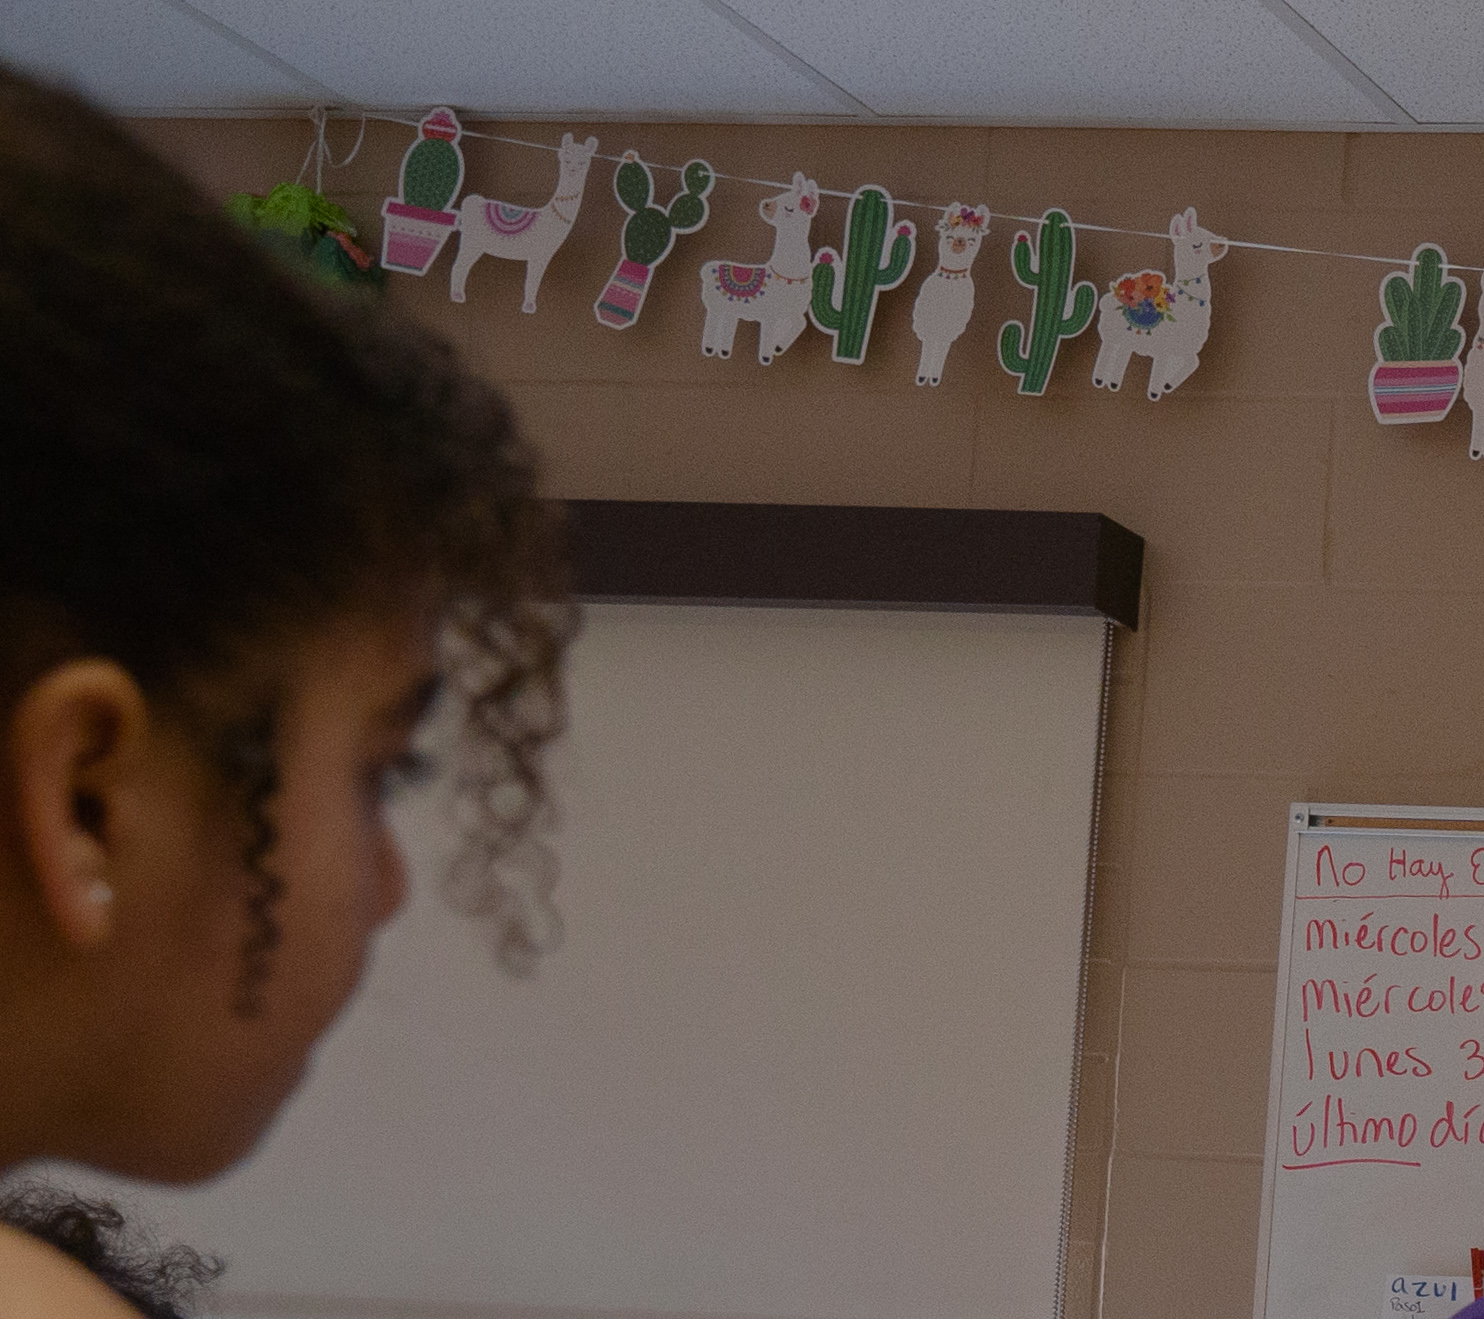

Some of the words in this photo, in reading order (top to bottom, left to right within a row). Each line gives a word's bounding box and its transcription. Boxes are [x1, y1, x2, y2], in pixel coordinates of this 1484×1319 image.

[1316, 846, 1366, 886] No
[1390, 846, 1455, 899] Hay
[1306, 912, 1482, 961] miércoles
[1306, 1028, 1433, 1080] lunes
[1391, 1277, 1458, 1302] azul
